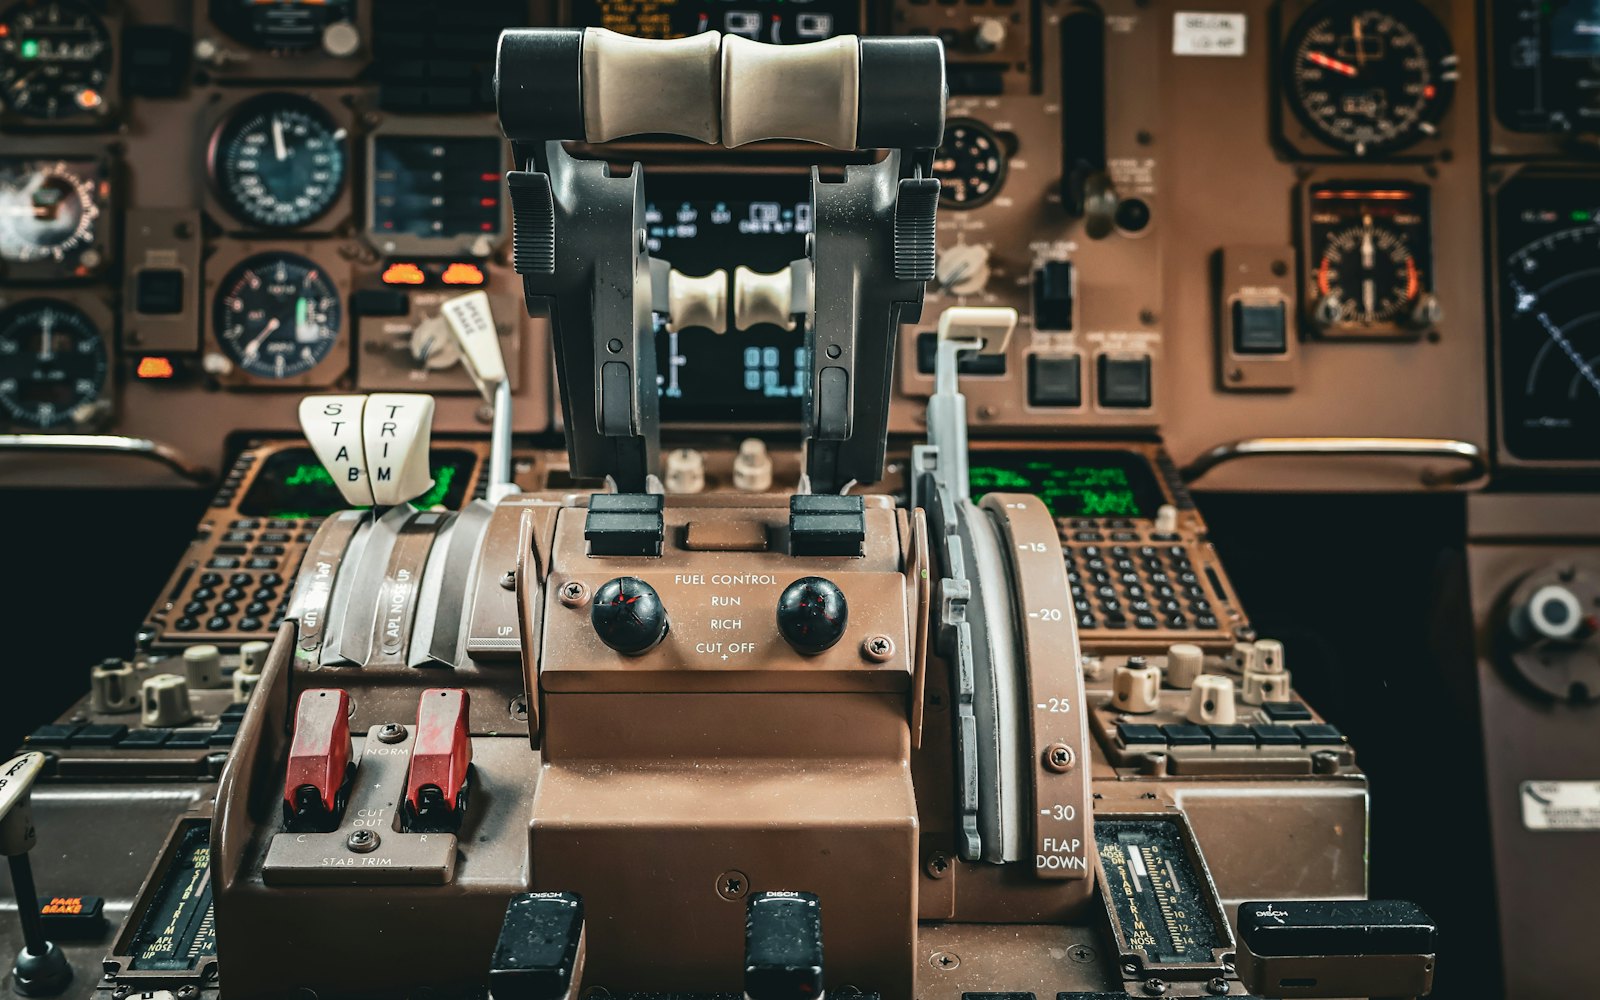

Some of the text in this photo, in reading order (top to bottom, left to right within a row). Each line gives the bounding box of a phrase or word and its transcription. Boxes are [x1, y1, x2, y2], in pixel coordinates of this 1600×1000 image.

[464, 300, 488, 331] SPEED
[451, 305, 476, 337] BRAKE
[674, 574, 777, 585] FUEL CONTROL
[387, 568, 412, 638] APL NOSE UP
[711, 596, 742, 607] RUN
[304, 611, 318, 628] UP
[710, 619, 742, 630] RICH
[497, 626, 513, 636] UP
[695, 643, 755, 653] CUT OFF
[366, 748, 409, 756] NORM
[357, 808, 385, 818] CUT
[352, 818, 384, 827] OUT
[296, 834, 306, 843] C
[420, 834, 428, 843] R
[1043, 838, 1081, 853] FLAP
[1103, 844, 1120, 852] APL
[1151, 845, 1159, 853] 0
[194, 861, 208, 869] DN
[321, 857, 392, 866] STAB TRIM
[1036, 854, 1087, 869] DOWN
[181, 869, 201, 900] STAB
[1117, 866, 1133, 895] STAB
[1164, 880, 1171, 889] 6
[50, 897, 82, 905] PARK
[1169, 895, 1177, 904] 8
[41, 904, 83, 914] BRAKE
[1127, 897, 1145, 930] TRIM
[163, 902, 186, 935] TRIM
[1174, 910, 1185, 919] 10
[1178, 924, 1189, 932] 12
[1133, 930, 1152, 938] APL
[1130, 938, 1156, 946] NOSE
[1183, 937, 1194, 945] 14
[147, 943, 173, 952] NOSE
[202, 942, 213, 950] 14
[142, 951, 156, 959] UP
